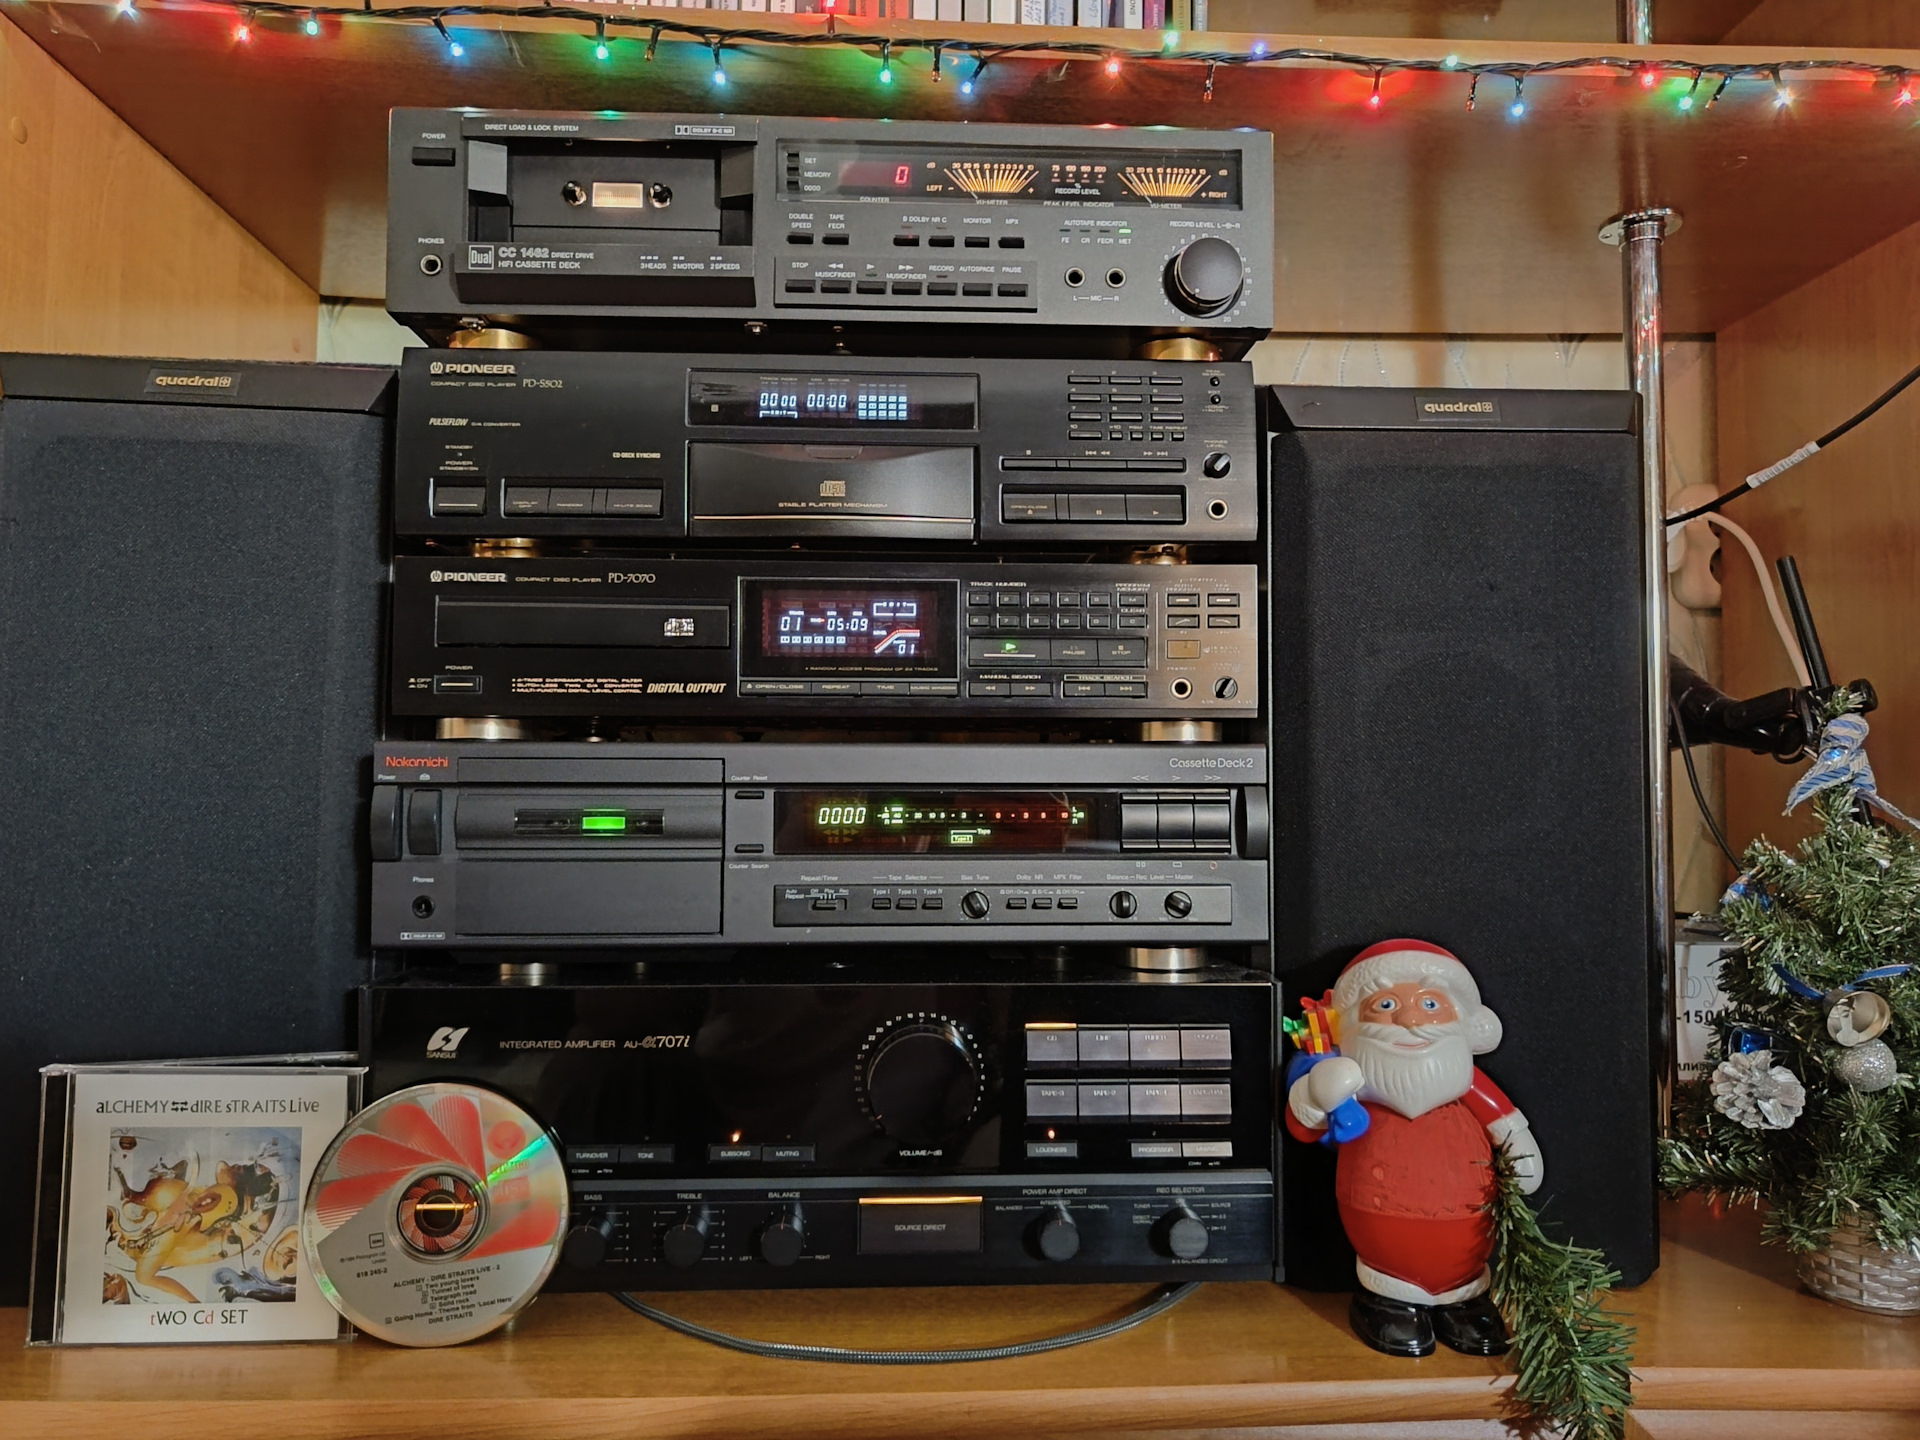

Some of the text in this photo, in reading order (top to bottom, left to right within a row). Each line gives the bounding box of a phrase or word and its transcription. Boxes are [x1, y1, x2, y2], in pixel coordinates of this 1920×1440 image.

[470, 249, 492, 264] Dual
[498, 248, 517, 258] CC
[498, 260, 580, 269] HIFI CASSETTE DECK
[445, 364, 516, 374] PIONEER
[156, 376, 219, 386] quadral
[1424, 402, 1481, 413] quadral
[429, 418, 468, 426] PULSEFLOW
[444, 573, 507, 582] PIONEER
[608, 573, 656, 583] PD-7070
[827, 618, 868, 631] 05:09
[647, 683, 726, 694] DIGITAL OUTPUT
[386, 756, 449, 767] Nakamichi
[1169, 758, 1245, 768] Cassette Deck
[500, 1040, 561, 1048] INTEGRATED
[564, 1040, 615, 1048] AMPLIFIER
[923, 1223, 946, 1231] DIRECT
[393, 1267, 491, 1288] ALCHEMY DIRE STRAITS LIVE
[438, 1279, 459, 1288] young
[460, 1276, 480, 1284] lovers
[430, 1292, 461, 1302] Telegraph
[439, 1300, 454, 1308] Solid
[221, 1309, 248, 1324] SET
[394, 1314, 413, 1323] Going
[415, 1311, 433, 1319] Home
[439, 1306, 460, 1314] Theme
[461, 1303, 475, 1311] from
[428, 1311, 473, 1324] DIRE STRAITS
